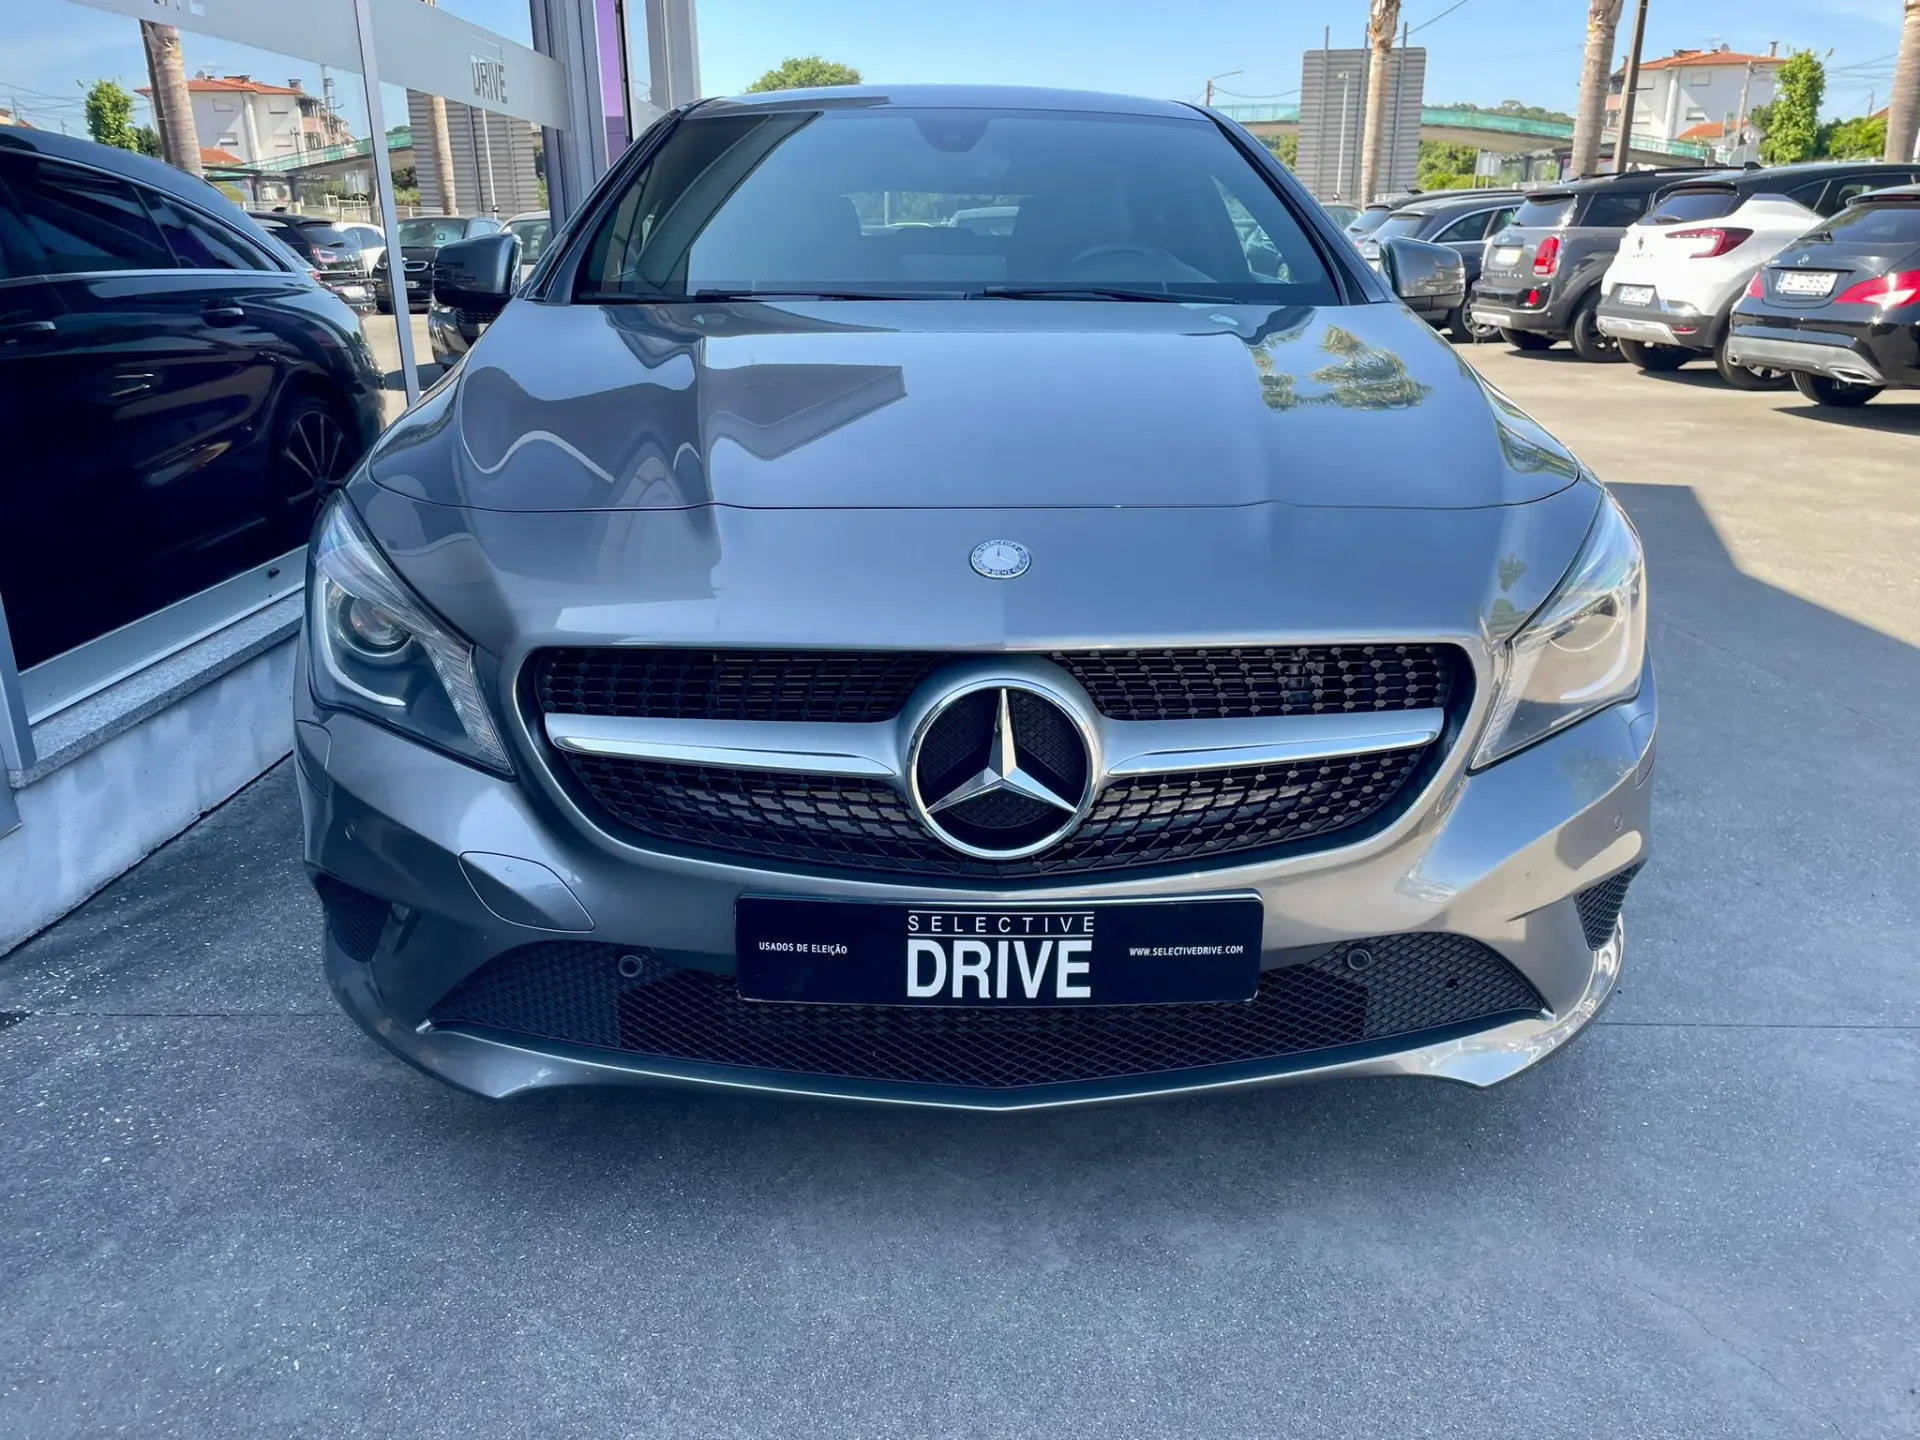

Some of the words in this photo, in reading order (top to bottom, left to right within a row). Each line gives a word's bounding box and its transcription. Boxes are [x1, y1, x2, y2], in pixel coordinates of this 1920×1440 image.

[907, 915, 1095, 933] SELECTIVE
[758, 942, 794, 952] USADOS
[796, 943, 809, 953] DE
[811, 944, 848, 956] ELEIÇÃO
[1129, 945, 1244, 956] WWW.SELECTIVEDRIVE.COM
[907, 939, 1093, 999] DRIVE
